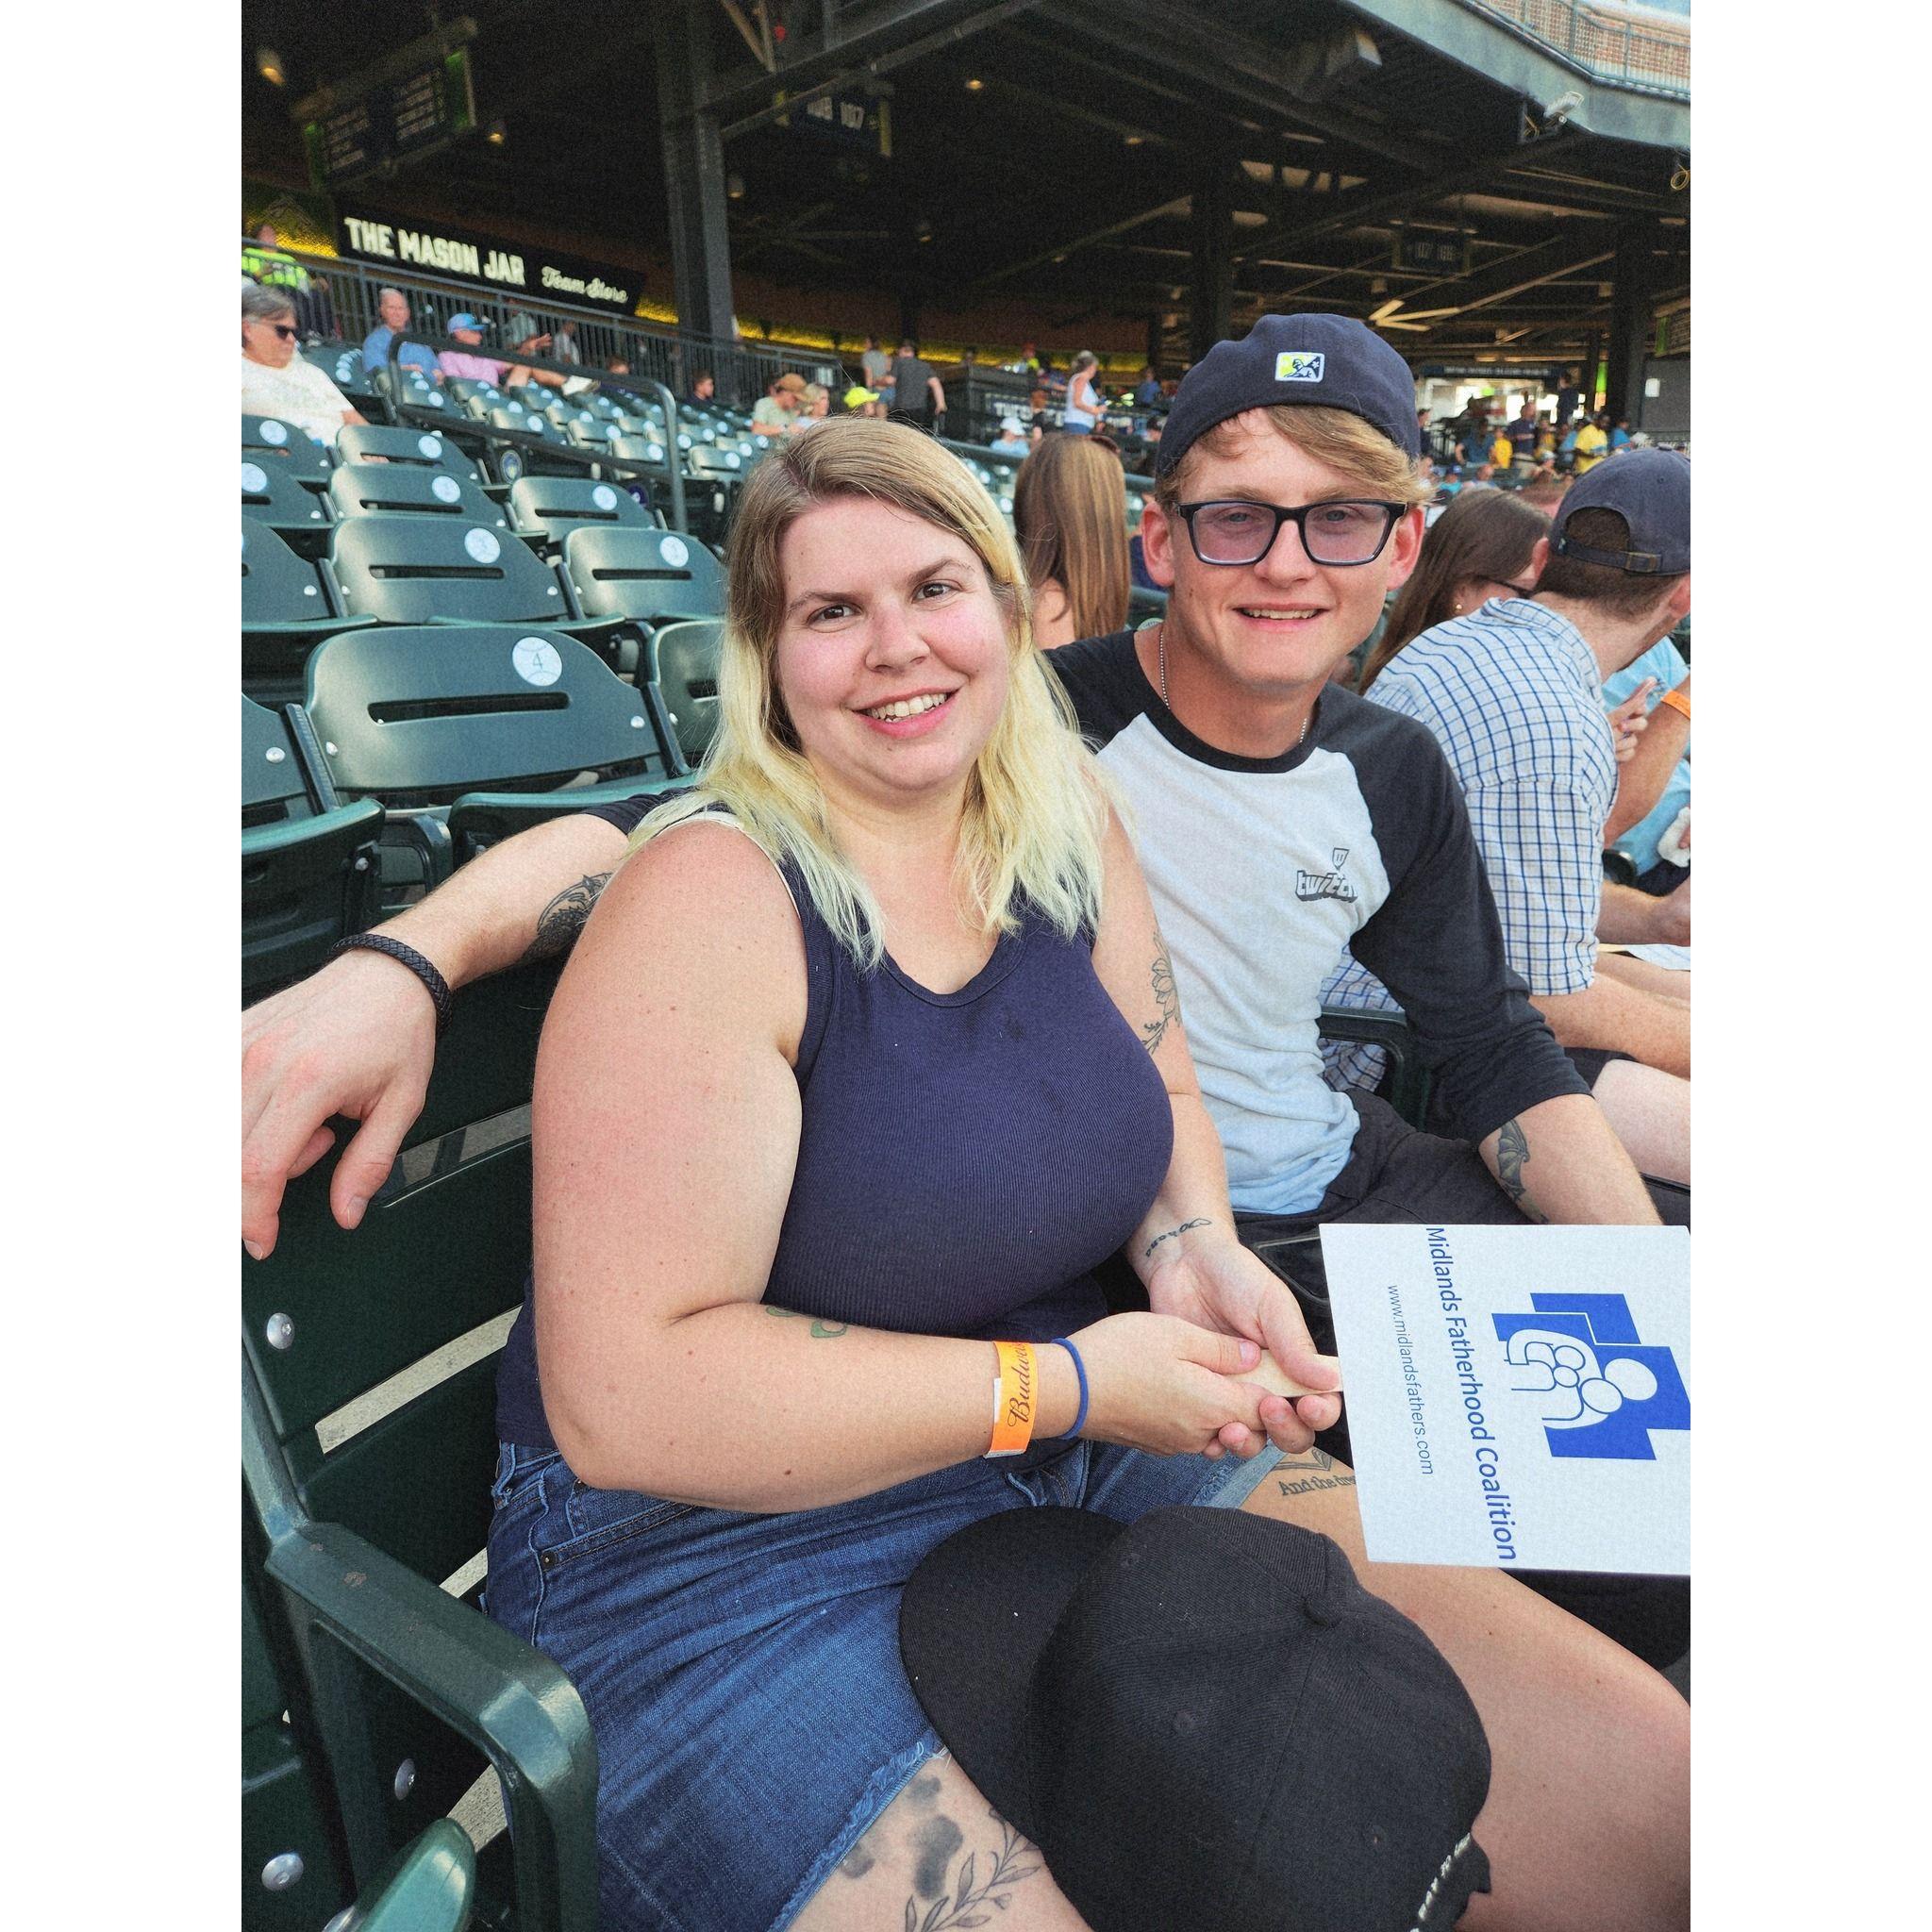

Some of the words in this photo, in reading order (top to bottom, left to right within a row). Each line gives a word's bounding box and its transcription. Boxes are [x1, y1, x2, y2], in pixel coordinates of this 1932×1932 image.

[344, 217, 396, 258] THE
[398, 228, 481, 278] MASON
[483, 249, 525, 286] JAR
[541, 266, 585, 294] Team
[585, 277, 628, 304] Store
[1388, 1285, 1434, 1474] www.midlandsfathers.com
[1426, 1228, 1462, 1311] Midlands
[1446, 1317, 1496, 1441] Fatherhood
[1475, 1447, 1516, 1559] Coalition
[1278, 1478, 1315, 1495] And
[1311, 1476, 1337, 1490] the
